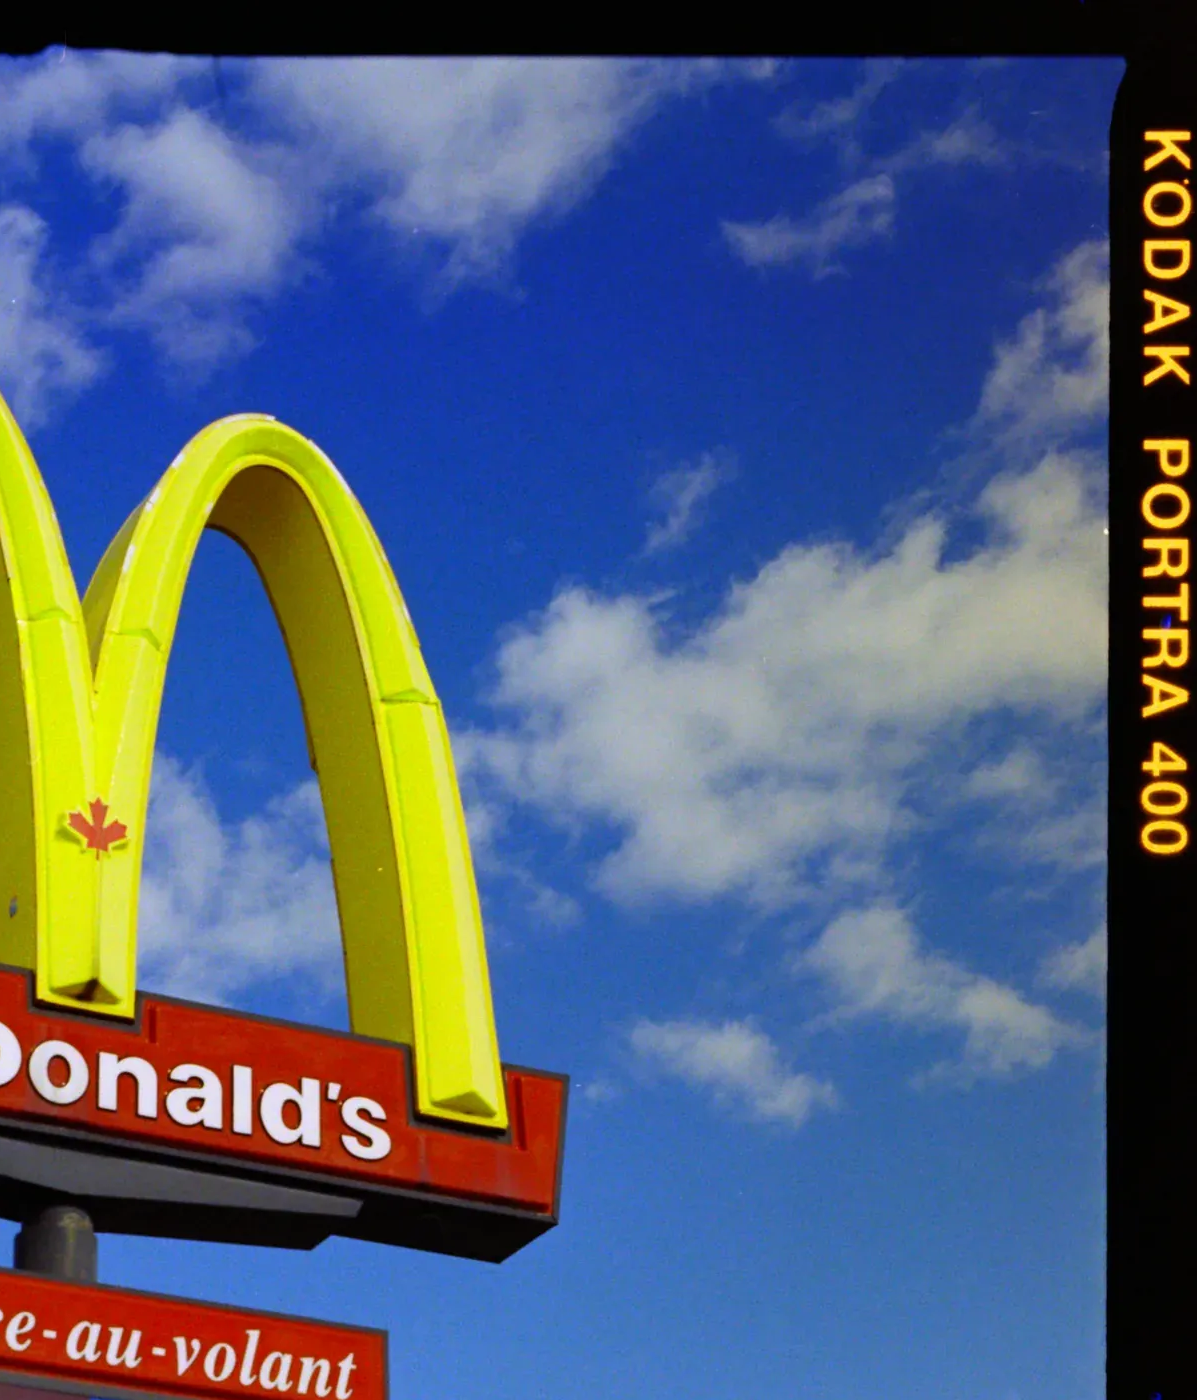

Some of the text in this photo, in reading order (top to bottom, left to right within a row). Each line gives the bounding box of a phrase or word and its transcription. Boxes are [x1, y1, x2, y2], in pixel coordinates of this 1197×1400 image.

[1140, 130, 1192, 855] KODAK PORTRA 400
